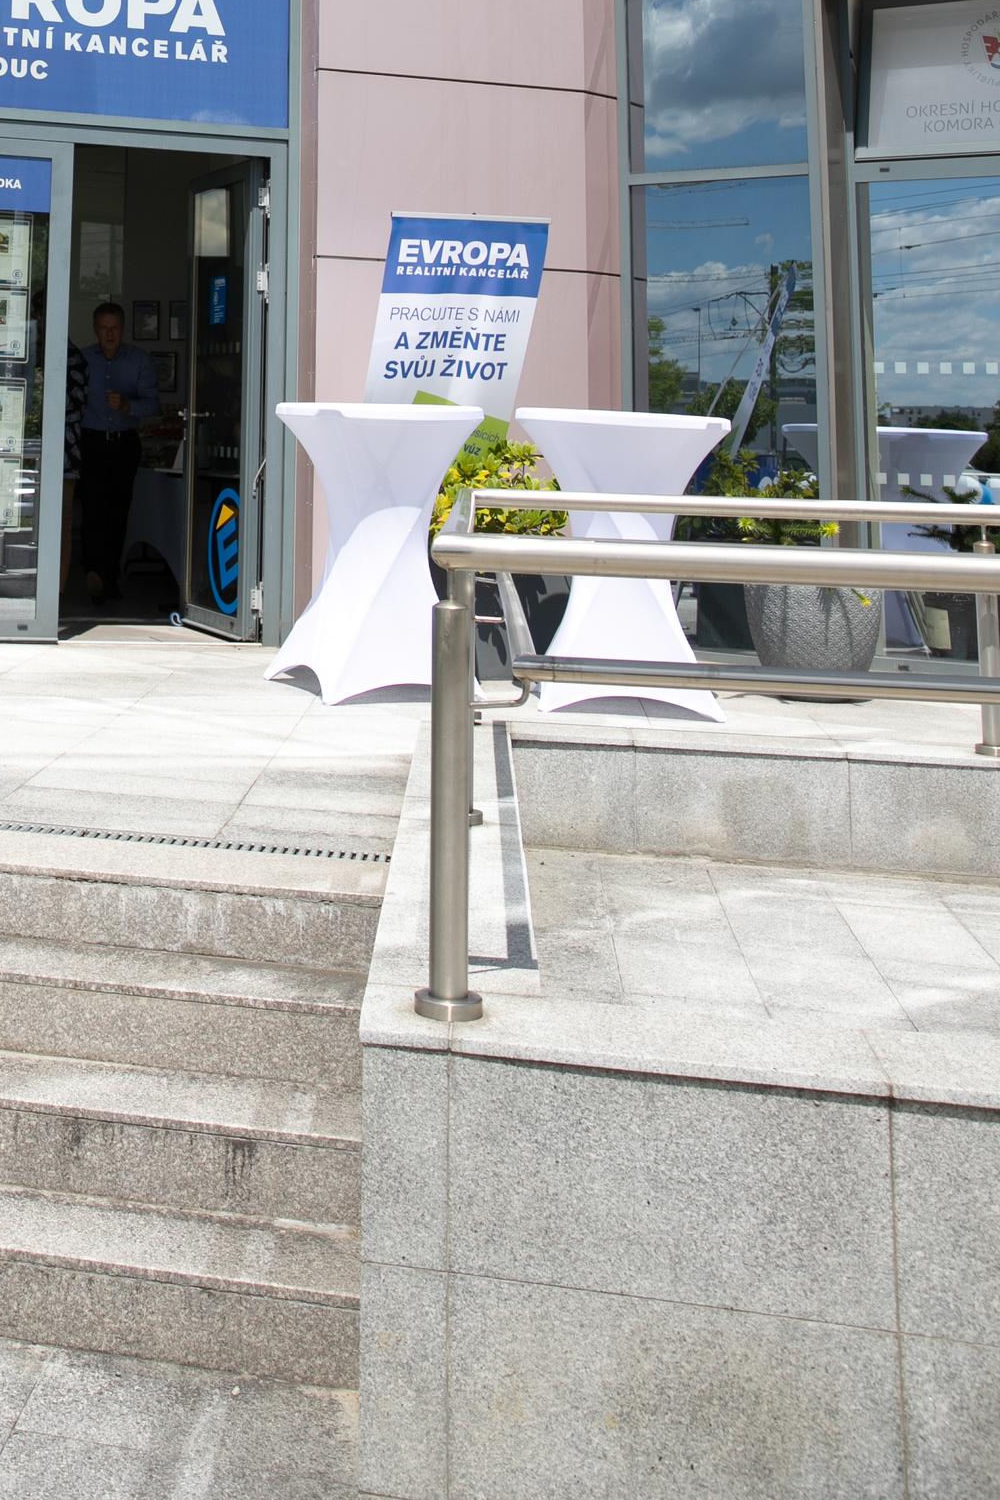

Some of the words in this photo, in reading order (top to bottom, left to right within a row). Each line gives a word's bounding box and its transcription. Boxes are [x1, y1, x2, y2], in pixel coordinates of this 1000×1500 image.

[65, 32, 228, 63] KANCELÁŘ
[923, 117, 994, 132] KOMORA
[398, 238, 529, 268] EVROPA
[396, 265, 456, 276] REALITNÍ
[459, 267, 529, 279] KANCELÁŘ
[390, 306, 465, 321] PRACUJTE
[468, 307, 479, 321] S
[483, 306, 520, 323] NÁMI
[394, 331, 410, 350] A
[415, 326, 507, 352] ZMĚŇTE
[383, 355, 436, 380] SVŮJ
[440, 354, 508, 381] ŽIVOT
